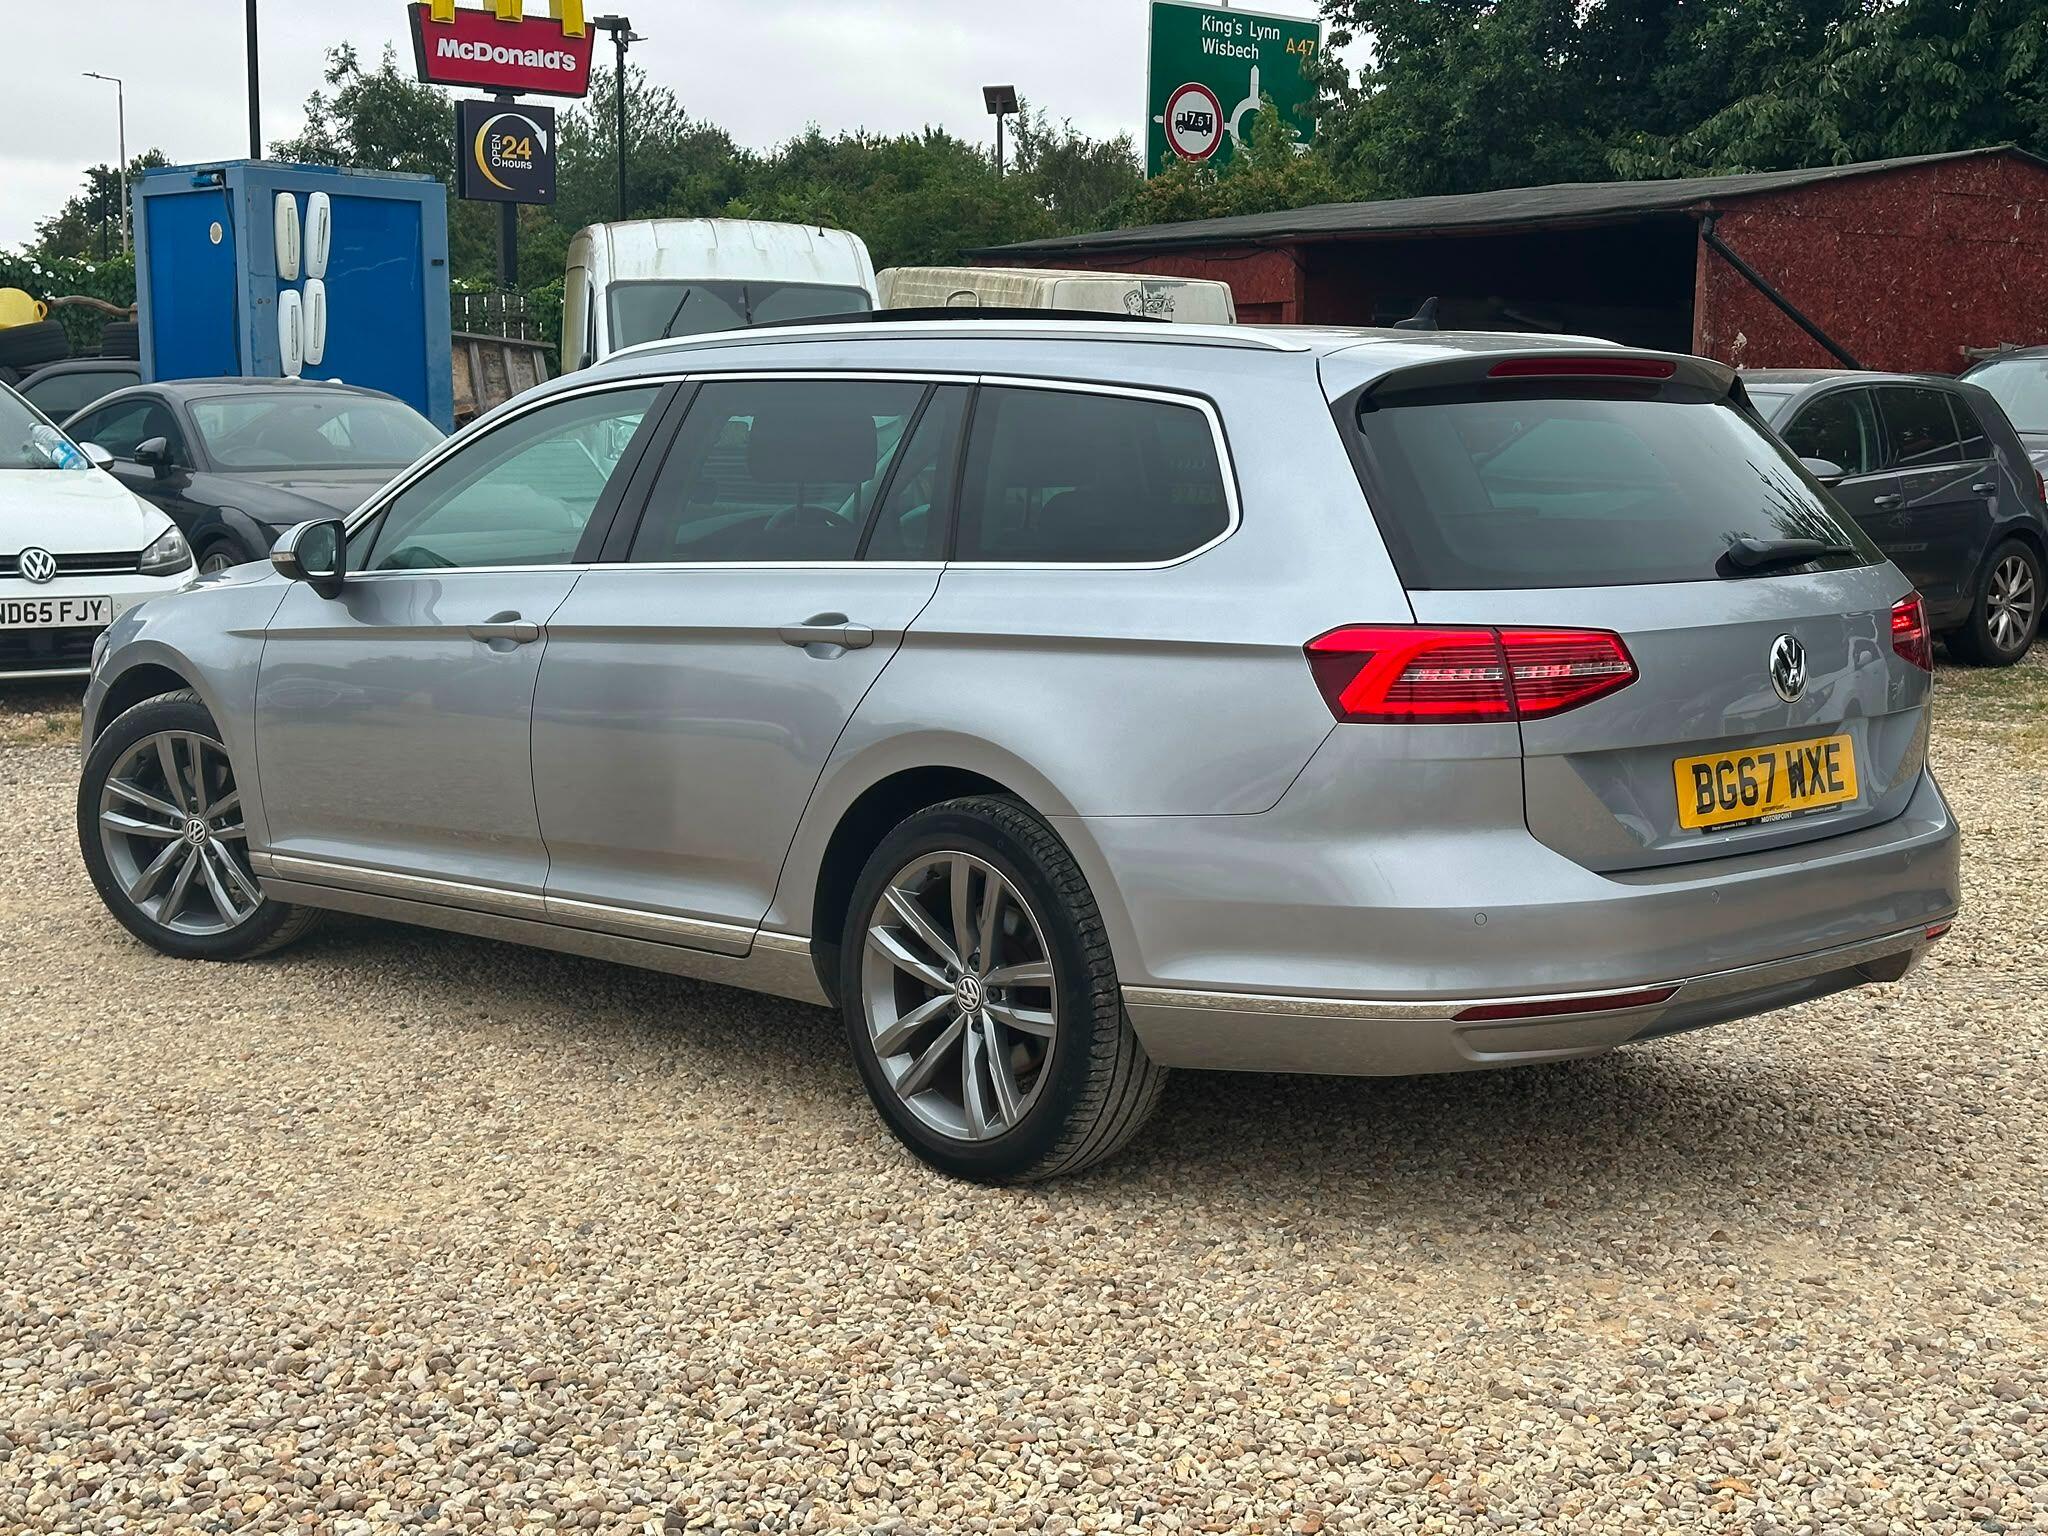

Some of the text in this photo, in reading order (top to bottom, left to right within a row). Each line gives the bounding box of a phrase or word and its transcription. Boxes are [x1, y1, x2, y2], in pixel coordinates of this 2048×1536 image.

[1202, 15, 1280, 41] King's Lynn
[436, 38, 577, 71] McDonald's
[1202, 38, 1259, 60] Wisbech
[1286, 37, 1315, 56] A47
[491, 134, 502, 167] OPEN
[502, 135, 532, 160] 24
[501, 159, 533, 170] HOURS
[60, 600, 102, 622] FJY
[1692, 742, 1845, 815] BG67 WXE
